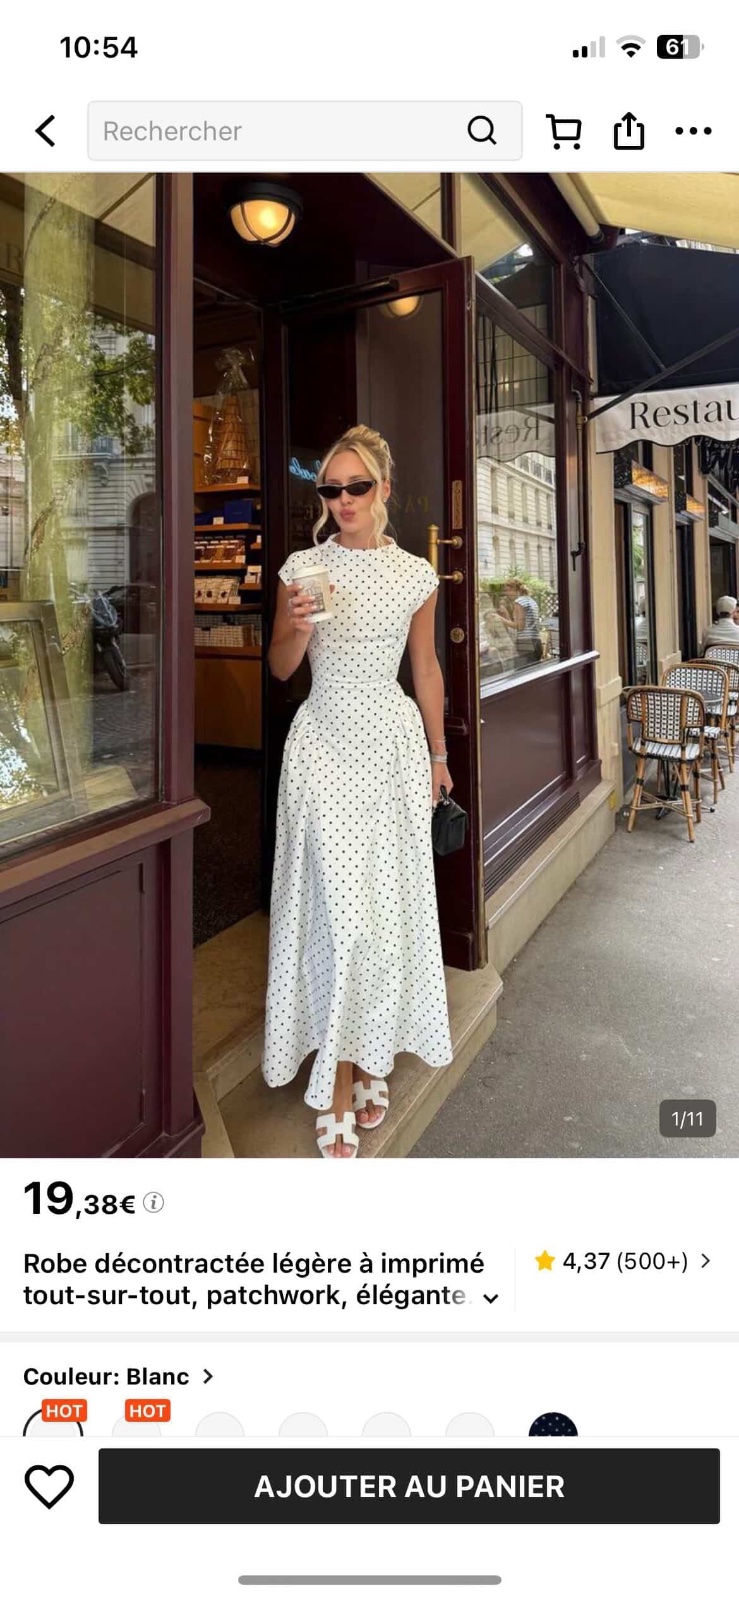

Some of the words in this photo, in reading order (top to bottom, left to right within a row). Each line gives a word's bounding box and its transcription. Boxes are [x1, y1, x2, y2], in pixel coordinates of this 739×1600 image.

[60, 36, 138, 58] 10:54
[666, 38, 690, 56] 61
[103, 120, 243, 142] Rechercher
[671, 1110, 703, 1130] 1/11
[23, 1180, 136, 1220] 19,38€
[24, 1252, 87, 1274] Robe
[95, 1251, 265, 1274] décontractée
[272, 1251, 352, 1279] légère
[359, 1251, 374, 1274] à
[382, 1251, 485, 1279] imprimé
[562, 1251, 611, 1274] 4,37
[617, 1251, 688, 1274] (500+)
[23, 1285, 198, 1311] tout-sur-tout,
[206, 1283, 347, 1311] patchwork,
[23, 1366, 119, 1386] Couleur:
[127, 1366, 190, 1386] Blanc
[46, 1404, 84, 1418] HOT
[129, 1404, 167, 1418] HOT
[253, 1474, 397, 1499] AJOUTER
[404, 1474, 447, 1499] AU
[456, 1474, 565, 1499] PANIER
